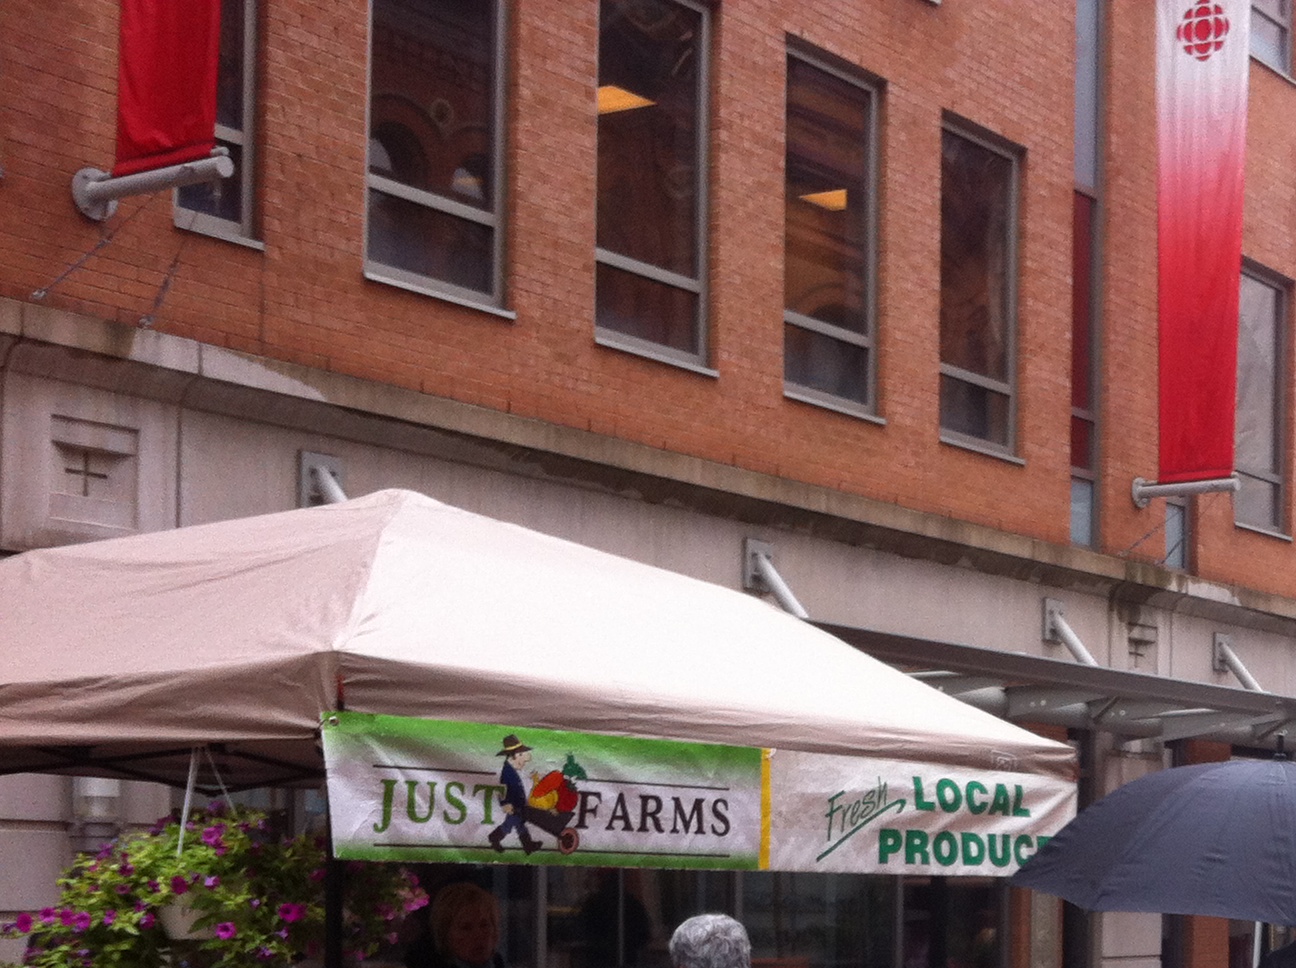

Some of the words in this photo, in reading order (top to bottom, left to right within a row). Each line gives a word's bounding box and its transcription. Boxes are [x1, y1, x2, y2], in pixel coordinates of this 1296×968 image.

[373, 779, 507, 833] JUST
[575, 790, 731, 837] FARMS
[825, 776, 888, 841] Fresh
[912, 776, 1031, 817] LOCAL
[878, 828, 1056, 867] PRODUC
